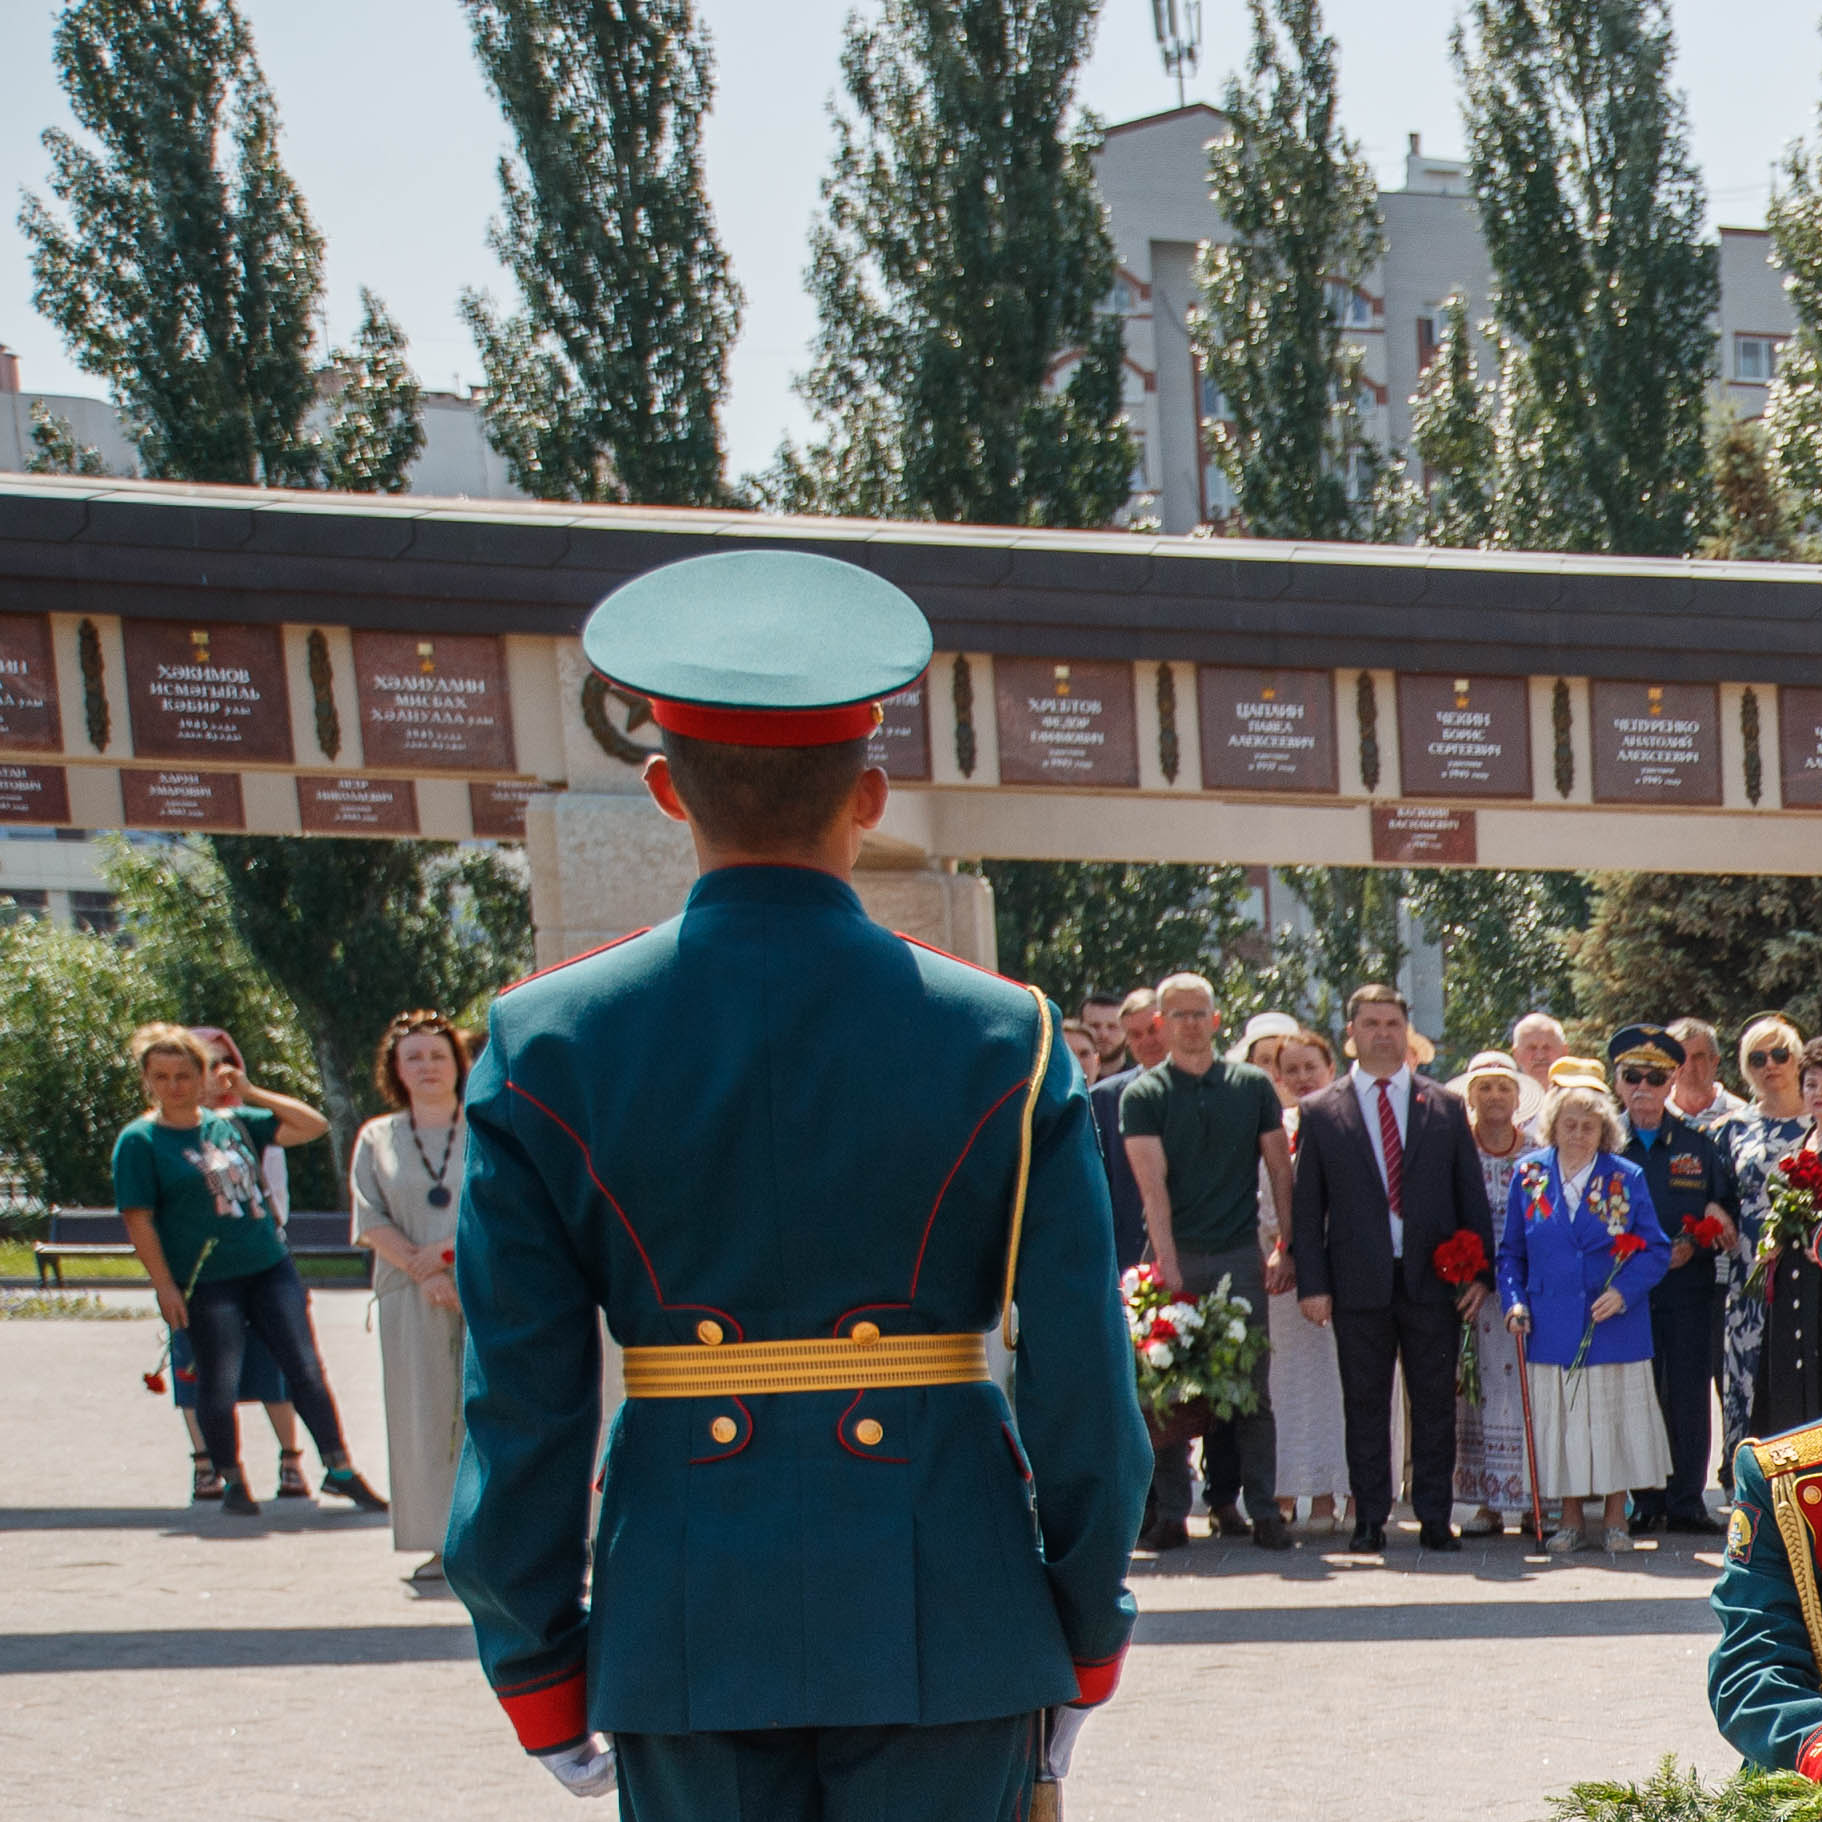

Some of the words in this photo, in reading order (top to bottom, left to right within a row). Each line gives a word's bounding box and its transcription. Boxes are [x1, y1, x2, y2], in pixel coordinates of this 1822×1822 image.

[158, 664, 250, 684] ХӘКИМОВ
[150, 682, 260, 700] ИСМӘГЫЙЛЬ
[162, 698, 220, 714] КӘБИР
